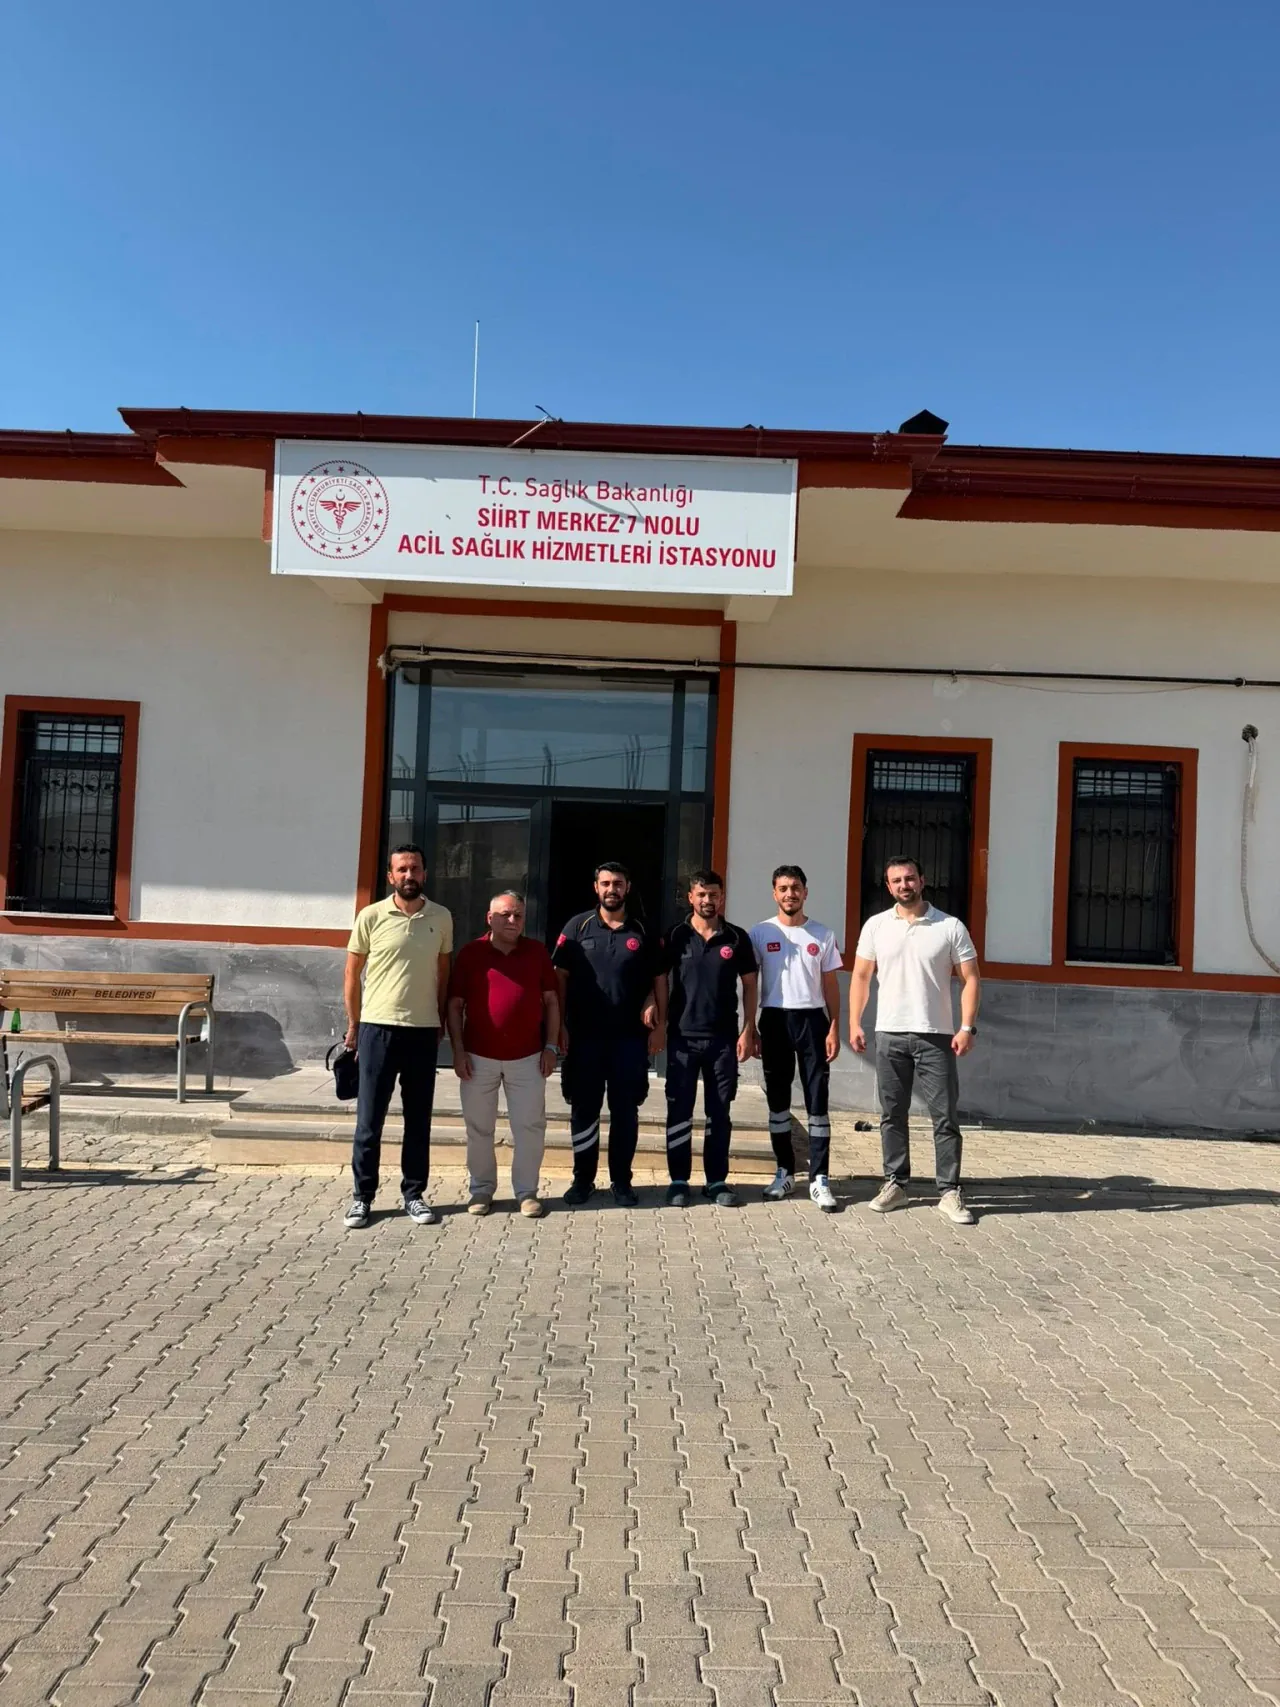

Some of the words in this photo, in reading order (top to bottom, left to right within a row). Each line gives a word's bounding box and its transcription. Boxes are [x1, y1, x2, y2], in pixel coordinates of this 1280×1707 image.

[478, 475, 517, 496] T.C.
[525, 478, 588, 503] Sağlık
[597, 481, 693, 508] Bakanlığı
[477, 503, 530, 529] SİİRT
[537, 511, 620, 533] MERKEZ
[627, 516, 637, 533] 7
[645, 516, 699, 536] NOLU
[398, 530, 445, 555] ACİL
[452, 533, 526, 559] SAĞLIK
[532, 536, 652, 564] HİZMETLERİ
[659, 541, 776, 568] İSTASYONU
[94, 989, 156, 999] BELEDİYESİ
